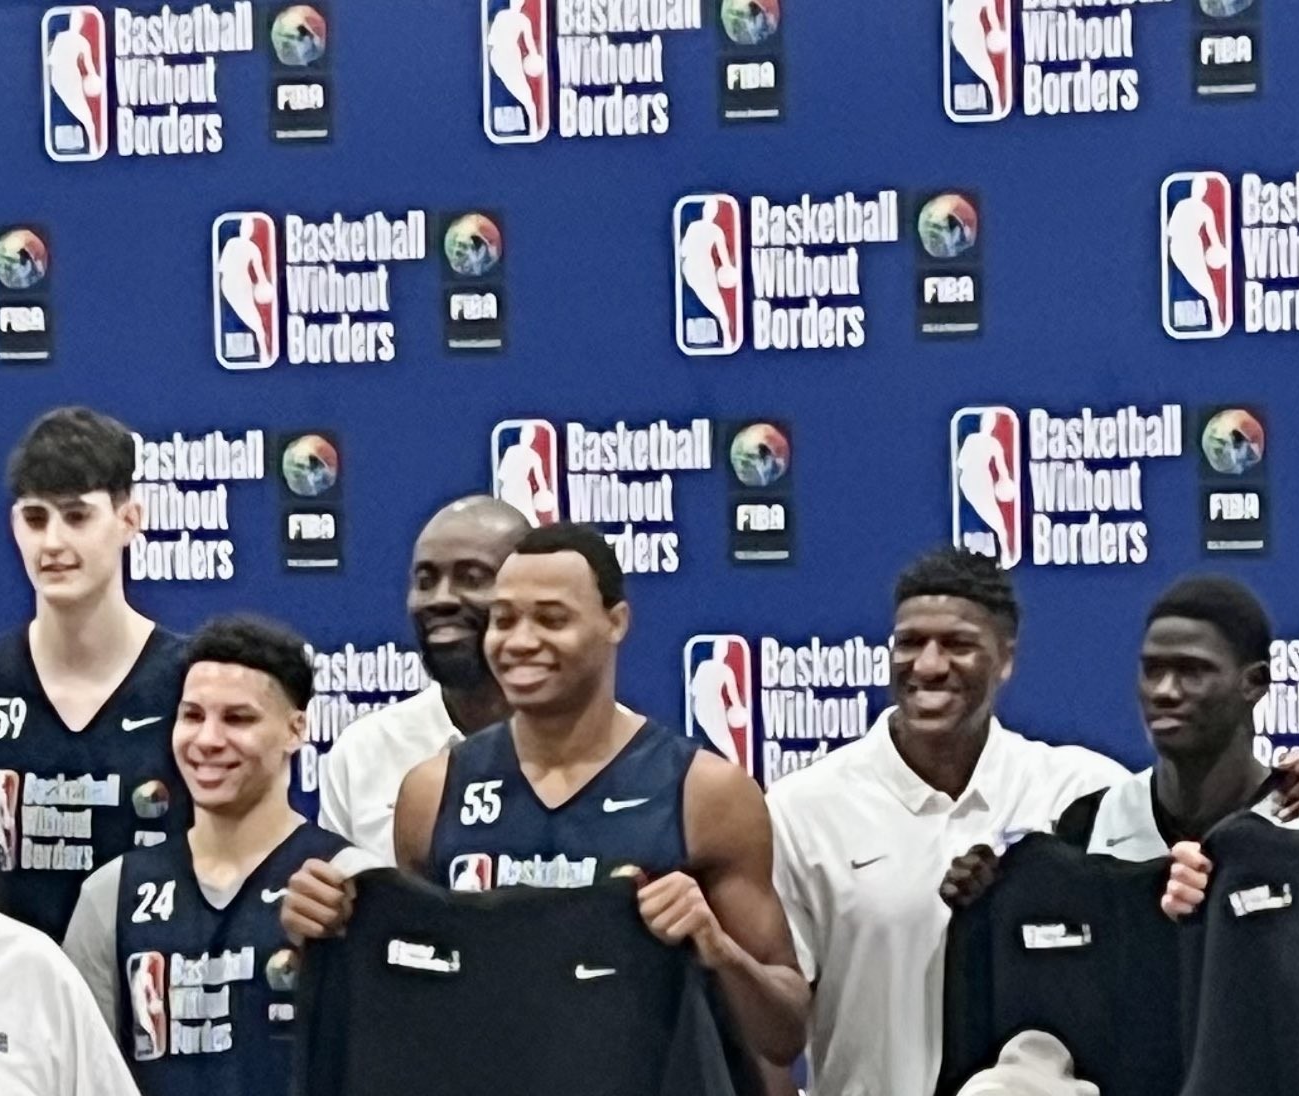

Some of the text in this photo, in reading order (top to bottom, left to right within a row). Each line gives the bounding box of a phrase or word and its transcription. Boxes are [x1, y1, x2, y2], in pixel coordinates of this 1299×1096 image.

[115, 1, 252, 55] Basketball
[1022, 9, 1132, 62] Without
[1201, 36, 1251, 64] FIBA
[115, 56, 217, 103] Without
[557, 35, 663, 85] Without
[727, 62, 774, 89] FIBA
[278, 84, 323, 110] FIBA
[560, 86, 668, 137] Borders
[1024, 62, 1138, 115] Borders
[117, 105, 222, 156] Borders
[286, 210, 425, 263] Basketball
[751, 191, 898, 246] Basketball
[286, 264, 389, 313] Without
[751, 246, 859, 298] Without
[925, 276, 973, 302] FIBA
[0, 307, 45, 332] FIBA
[451, 293, 497, 320] FIBA
[753, 298, 864, 349] Borders
[287, 313, 394, 364] Borders
[567, 419, 710, 471] Basketball
[1030, 405, 1181, 459] Basketball
[567, 473, 673, 523] Without
[1029, 460, 1142, 512] Without
[1210, 494, 1259, 520] FIBA
[289, 514, 334, 539] FIBA
[737, 504, 784, 530] FIBA
[1033, 513, 1147, 565] Borders
[130, 530, 234, 580] Borders
[604, 523, 679, 574] ders
[304, 642, 431, 692] asketba
[761, 635, 895, 688] Basketba
[761, 688, 868, 739] Without
[461, 780, 502, 825] 55
[132, 880, 175, 922] 24
